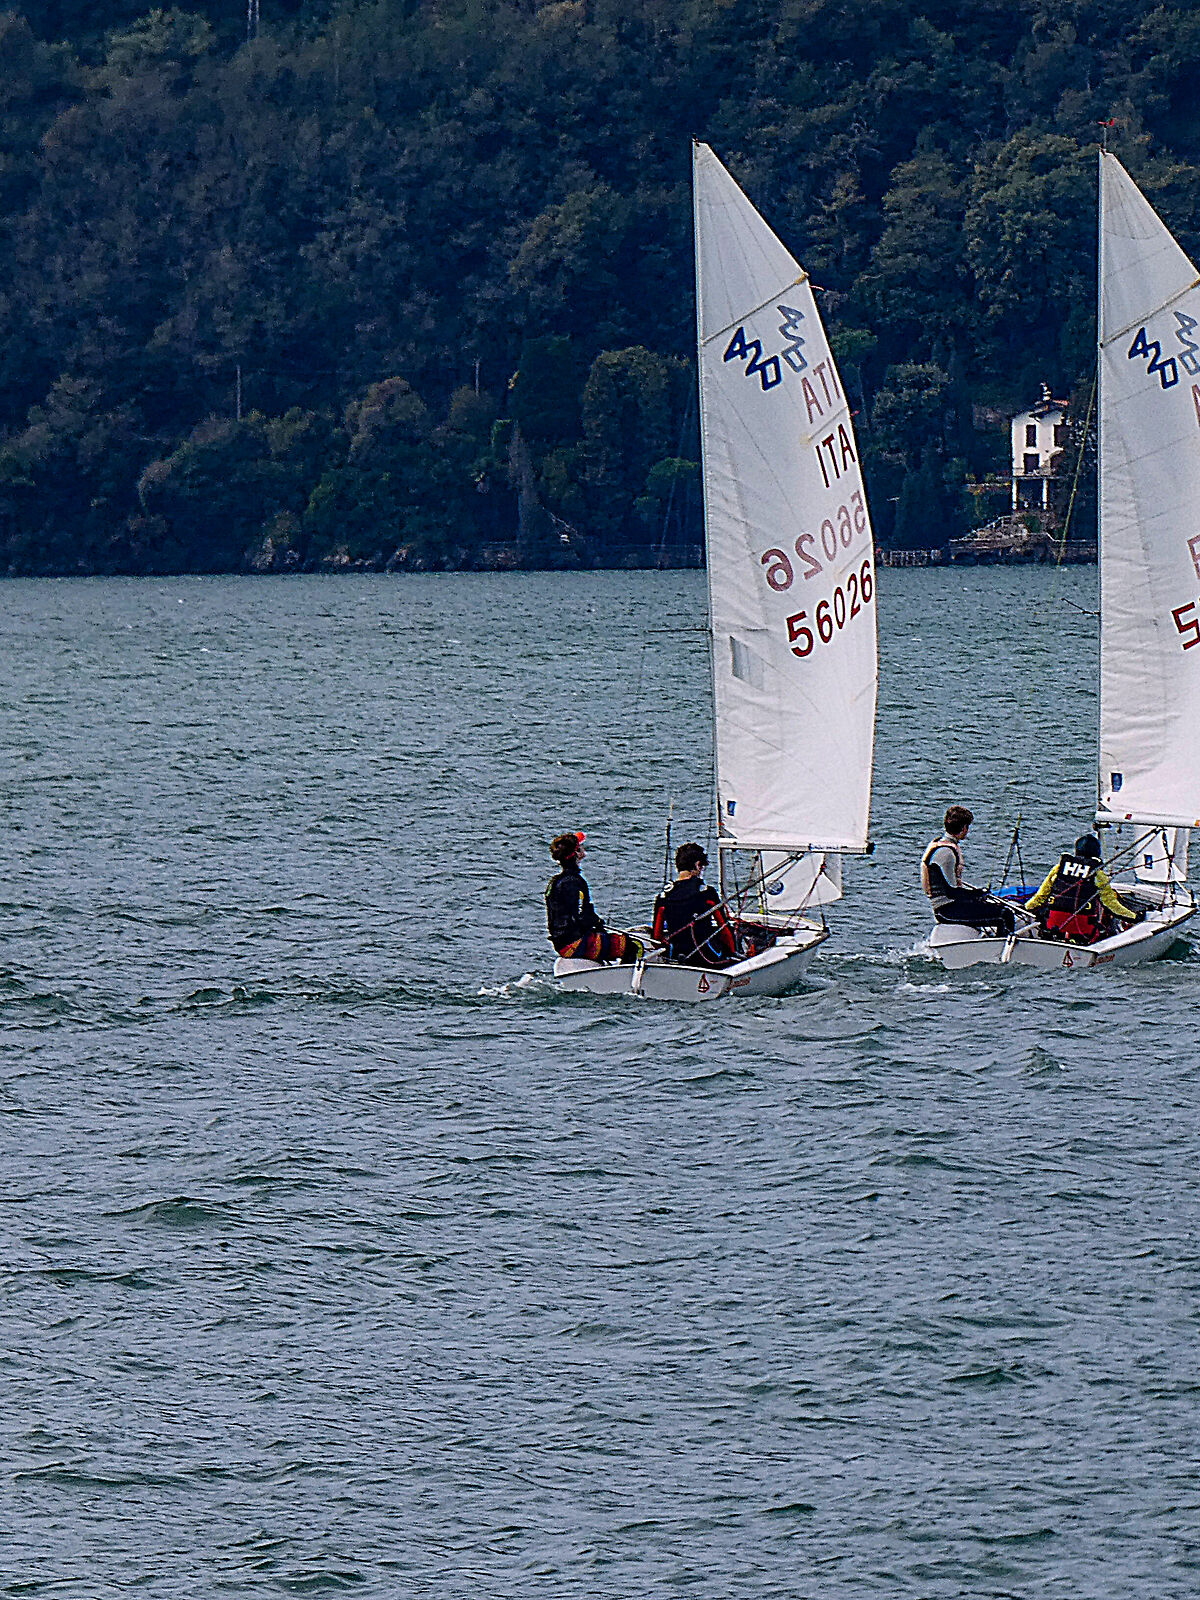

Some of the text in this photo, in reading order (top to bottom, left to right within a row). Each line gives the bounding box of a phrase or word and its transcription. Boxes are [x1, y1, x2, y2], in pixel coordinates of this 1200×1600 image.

[723, 326, 782, 391] 420
[1128, 326, 1181, 390] 420
[816, 422, 856, 489] ITA
[785, 559, 874, 658] 56026
[1063, 861, 1090, 878] HH
